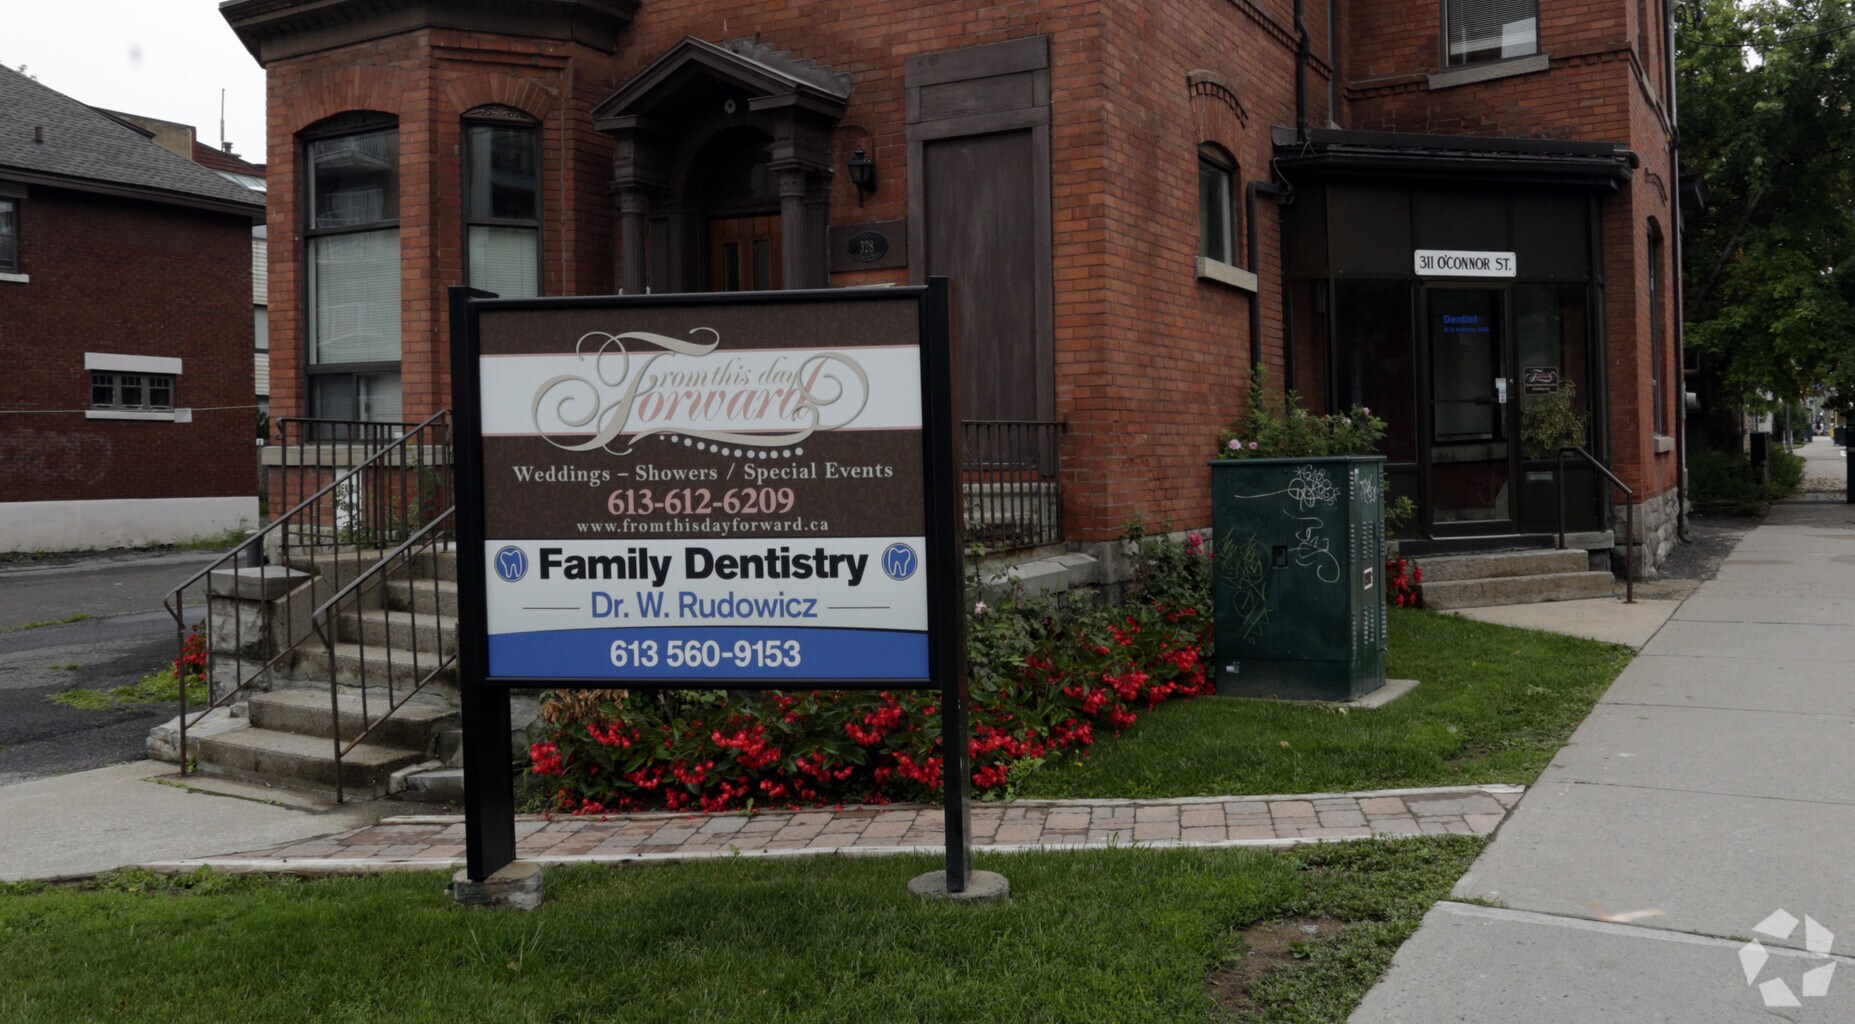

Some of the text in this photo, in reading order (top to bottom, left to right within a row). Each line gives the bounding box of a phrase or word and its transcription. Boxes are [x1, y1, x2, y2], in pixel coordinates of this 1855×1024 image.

[860, 240, 874, 253] 328
[1419, 254, 1512, 271] 311 O'CONNOR ST.
[1443, 314, 1479, 324] Dentist
[711, 357, 751, 387] this
[512, 465, 610, 487] Weddings
[635, 464, 718, 481] Showers
[744, 463, 817, 485] Special
[825, 462, 893, 479] Events
[607, 487, 795, 515] 613-612-6209
[576, 517, 829, 536] www.fromthisdayforward.ca
[539, 546, 869, 588] Family Dentistry
[591, 591, 818, 618] Dr. W. Rudowicz
[610, 639, 802, 668] 613 560-9153
